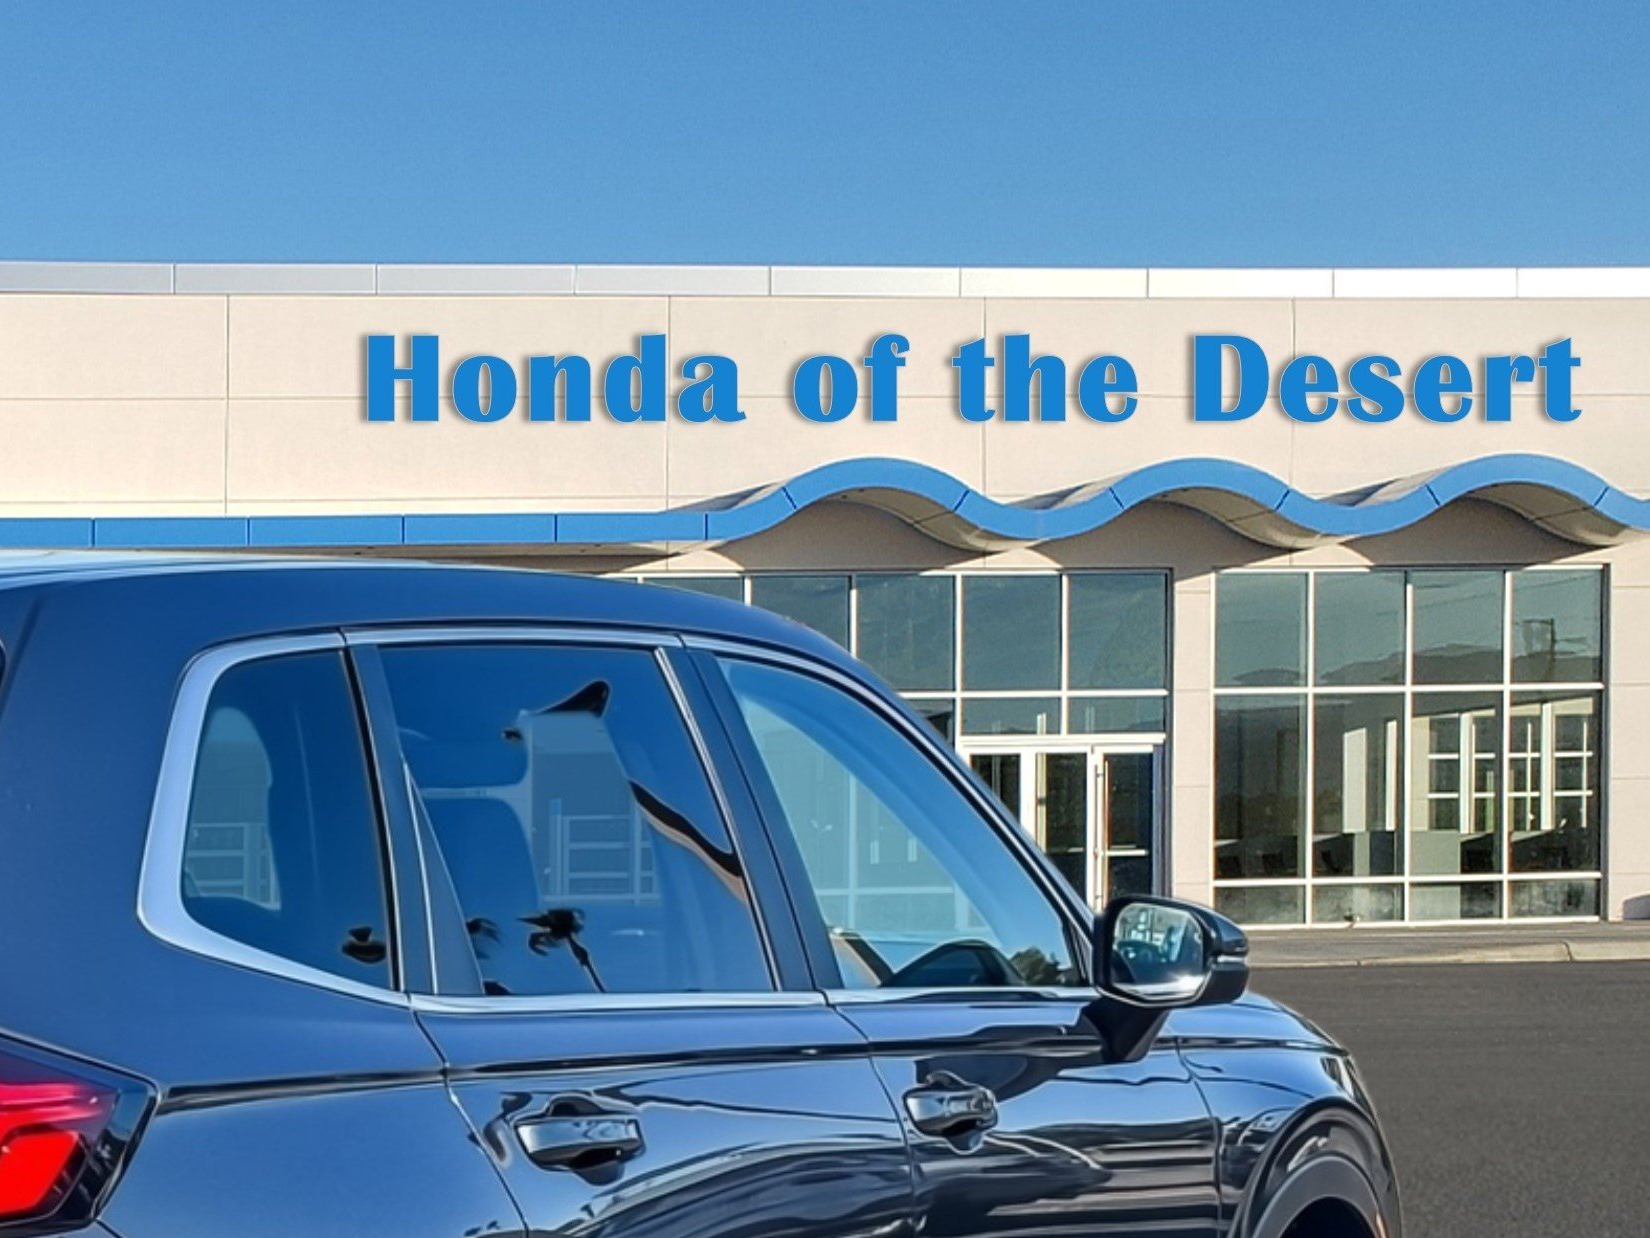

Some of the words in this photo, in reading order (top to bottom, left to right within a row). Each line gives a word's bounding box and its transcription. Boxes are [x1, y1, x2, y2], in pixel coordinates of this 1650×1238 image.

[366, 333, 748, 423] Honda
[792, 333, 911, 423] of
[951, 333, 1139, 423] the
[1193, 334, 1583, 423] Desert
